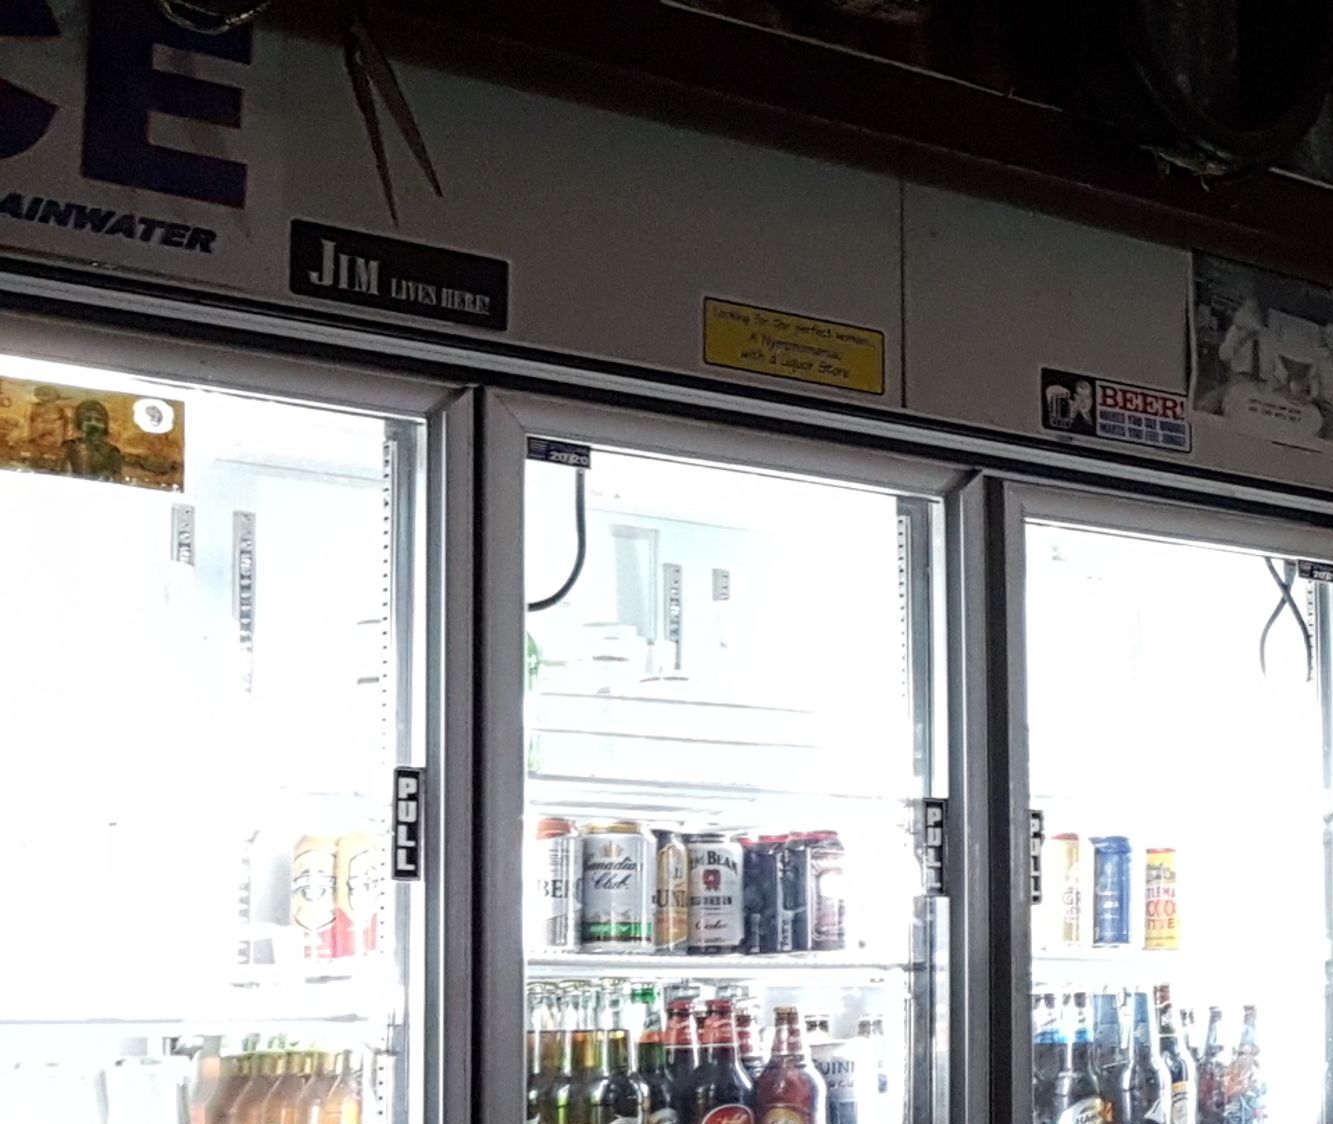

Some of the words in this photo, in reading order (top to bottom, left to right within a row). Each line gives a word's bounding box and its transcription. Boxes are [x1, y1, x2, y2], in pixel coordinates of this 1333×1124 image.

[308, 237, 381, 297] JIM
[390, 277, 437, 307] LIVES
[440, 286, 491, 316] HERE!
[1099, 385, 1185, 421] BEER!
[397, 776, 417, 870] PULL
[926, 806, 942, 888] PULL
